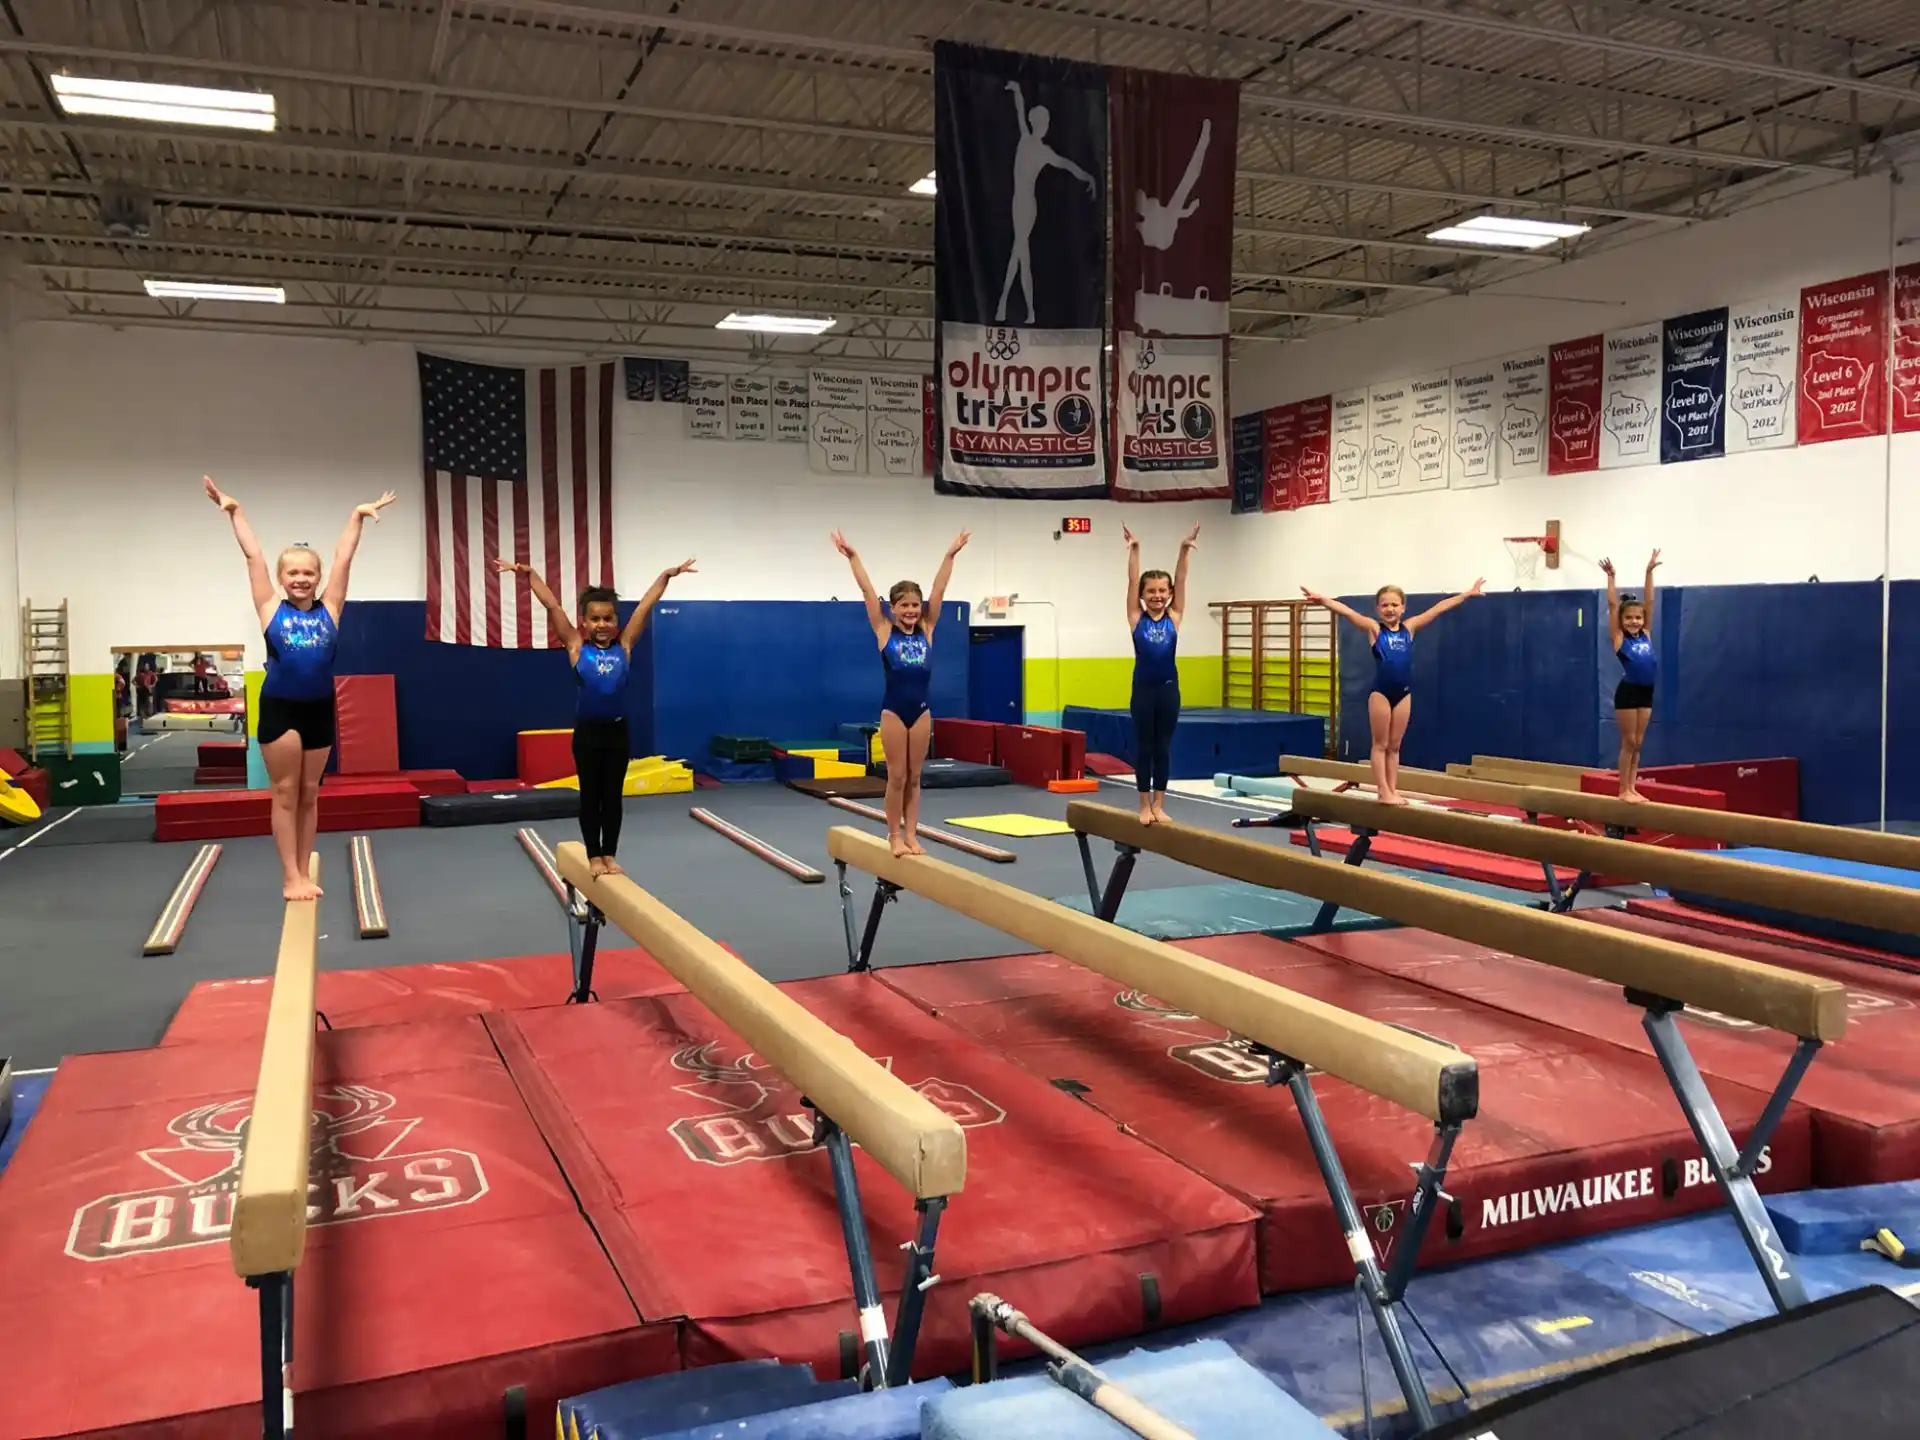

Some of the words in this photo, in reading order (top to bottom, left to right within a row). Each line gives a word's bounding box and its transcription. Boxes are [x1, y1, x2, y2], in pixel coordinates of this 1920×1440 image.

[1806, 285, 1875, 310] Wisconsin
[1733, 308, 1795, 331] Wisconsin
[1817, 308, 1864, 327] Gymnastics
[1667, 320, 1724, 342] Wisconsin
[1830, 320, 1851, 331] State
[986, 328, 1019, 341] USA
[1741, 328, 1784, 345] Gymnastics
[1807, 324, 1872, 345] Championships
[1608, 333, 1659, 352] Wisconsin
[1754, 340, 1771, 349] State
[1553, 344, 1600, 362] Wisconsin
[1732, 345, 1790, 363] Championships
[1502, 355, 1545, 372] Wisconsin
[1667, 355, 1721, 373] Championships
[813, 372, 863, 385] Wisconsin
[948, 352, 1091, 402] olympic
[1454, 373, 1494, 388] Wisconsin
[1812, 366, 1842, 384] Level
[1845, 366, 1853, 379] 6
[870, 376, 918, 389] Wisconsin
[1412, 379, 1448, 392] Wisconsin
[1740, 384, 1765, 399] Level
[1767, 384, 1773, 395] 4
[1817, 388, 1832, 400] 2nd
[1834, 386, 1856, 397] Place
[702, 397, 725, 407] Place
[746, 396, 768, 406] Place
[1671, 393, 1695, 409] Level
[1698, 392, 1708, 404] 10
[1741, 399, 1754, 410] 3rd
[1756, 397, 1777, 408] Place
[1830, 400, 1857, 414] 2012
[783, 412, 802, 420] Girls
[1611, 404, 1634, 417] Level
[1635, 403, 1641, 412] 5
[1678, 414, 1686, 423] 1st
[1688, 410, 1708, 421] Place
[1559, 411, 1579, 424] Level
[1752, 416, 1777, 429] 2012
[691, 421, 713, 429] Level
[822, 426, 842, 434] Level
[1507, 419, 1526, 430] Level
[1625, 420, 1641, 429] Place
[1688, 425, 1709, 437] 2011
[1518, 431, 1534, 439] Place
[1572, 427, 1588, 436] Place
[956, 433, 1091, 451] GYMNASTICS
[1413, 437, 1429, 448] Level
[1458, 433, 1473, 445] Level
[1625, 433, 1644, 444] 2011
[1481, 1167, 1654, 1228] MILWAUKEE
[1684, 1145, 1772, 1187] BUS
[100, 1157, 462, 1248] BUKS
